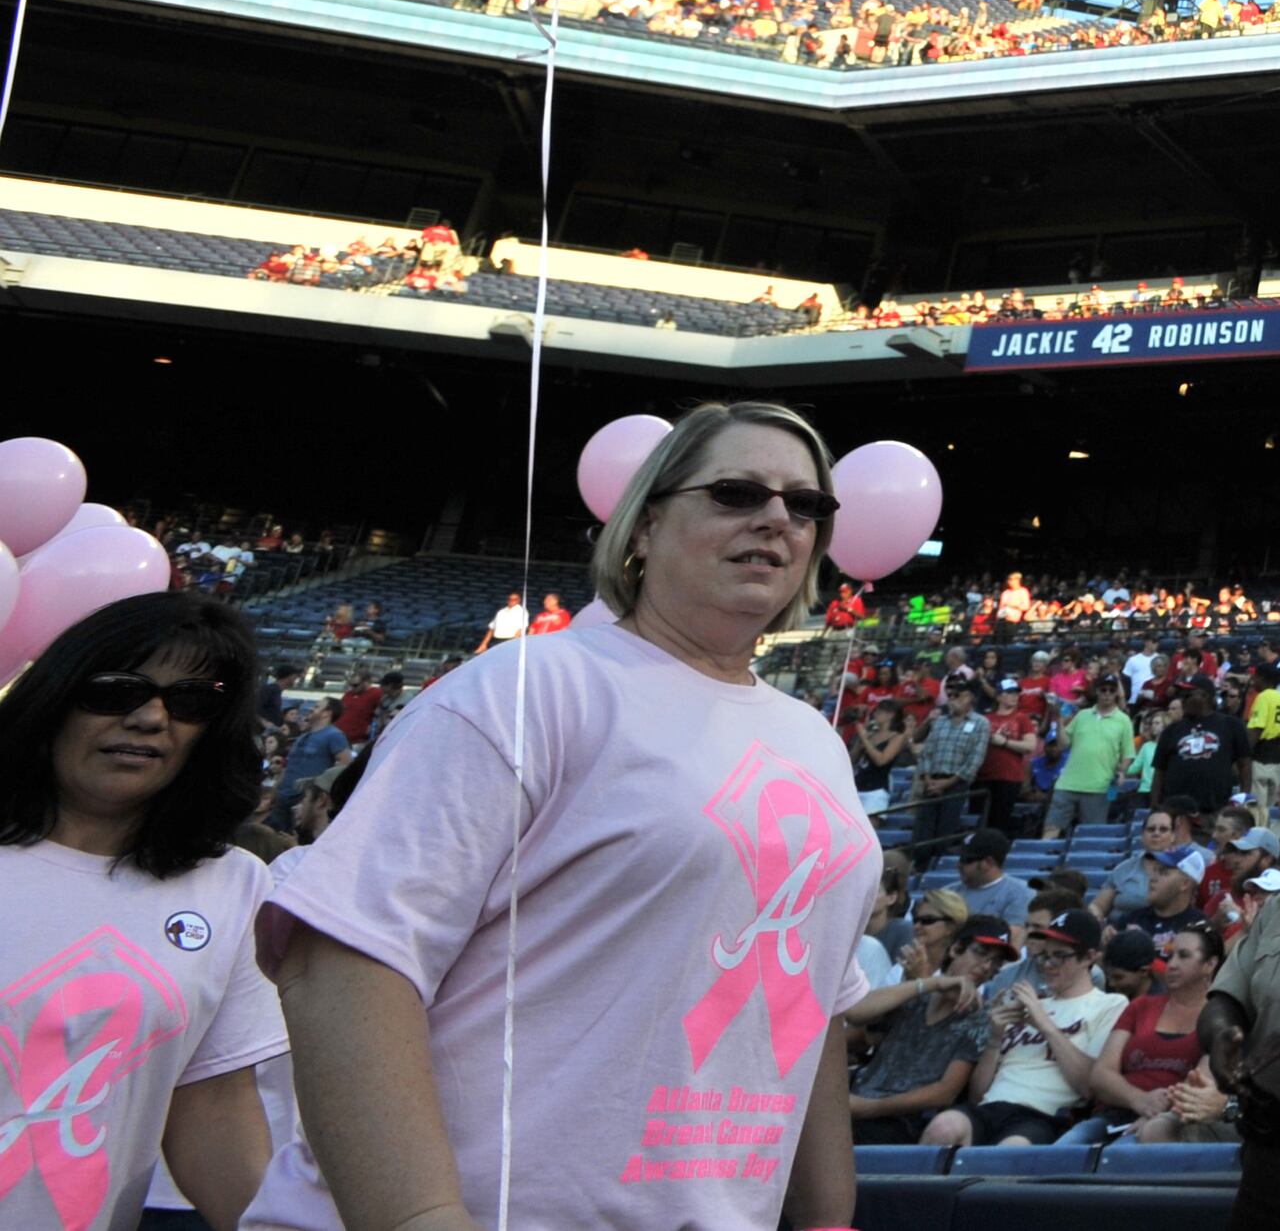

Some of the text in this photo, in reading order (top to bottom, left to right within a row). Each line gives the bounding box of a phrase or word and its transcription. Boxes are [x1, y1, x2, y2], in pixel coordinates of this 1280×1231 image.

[992, 319, 1264, 357] JACKIE 42 ROBINSON
[711, 847, 823, 976] A
[727, 1085, 797, 1114] Braves
